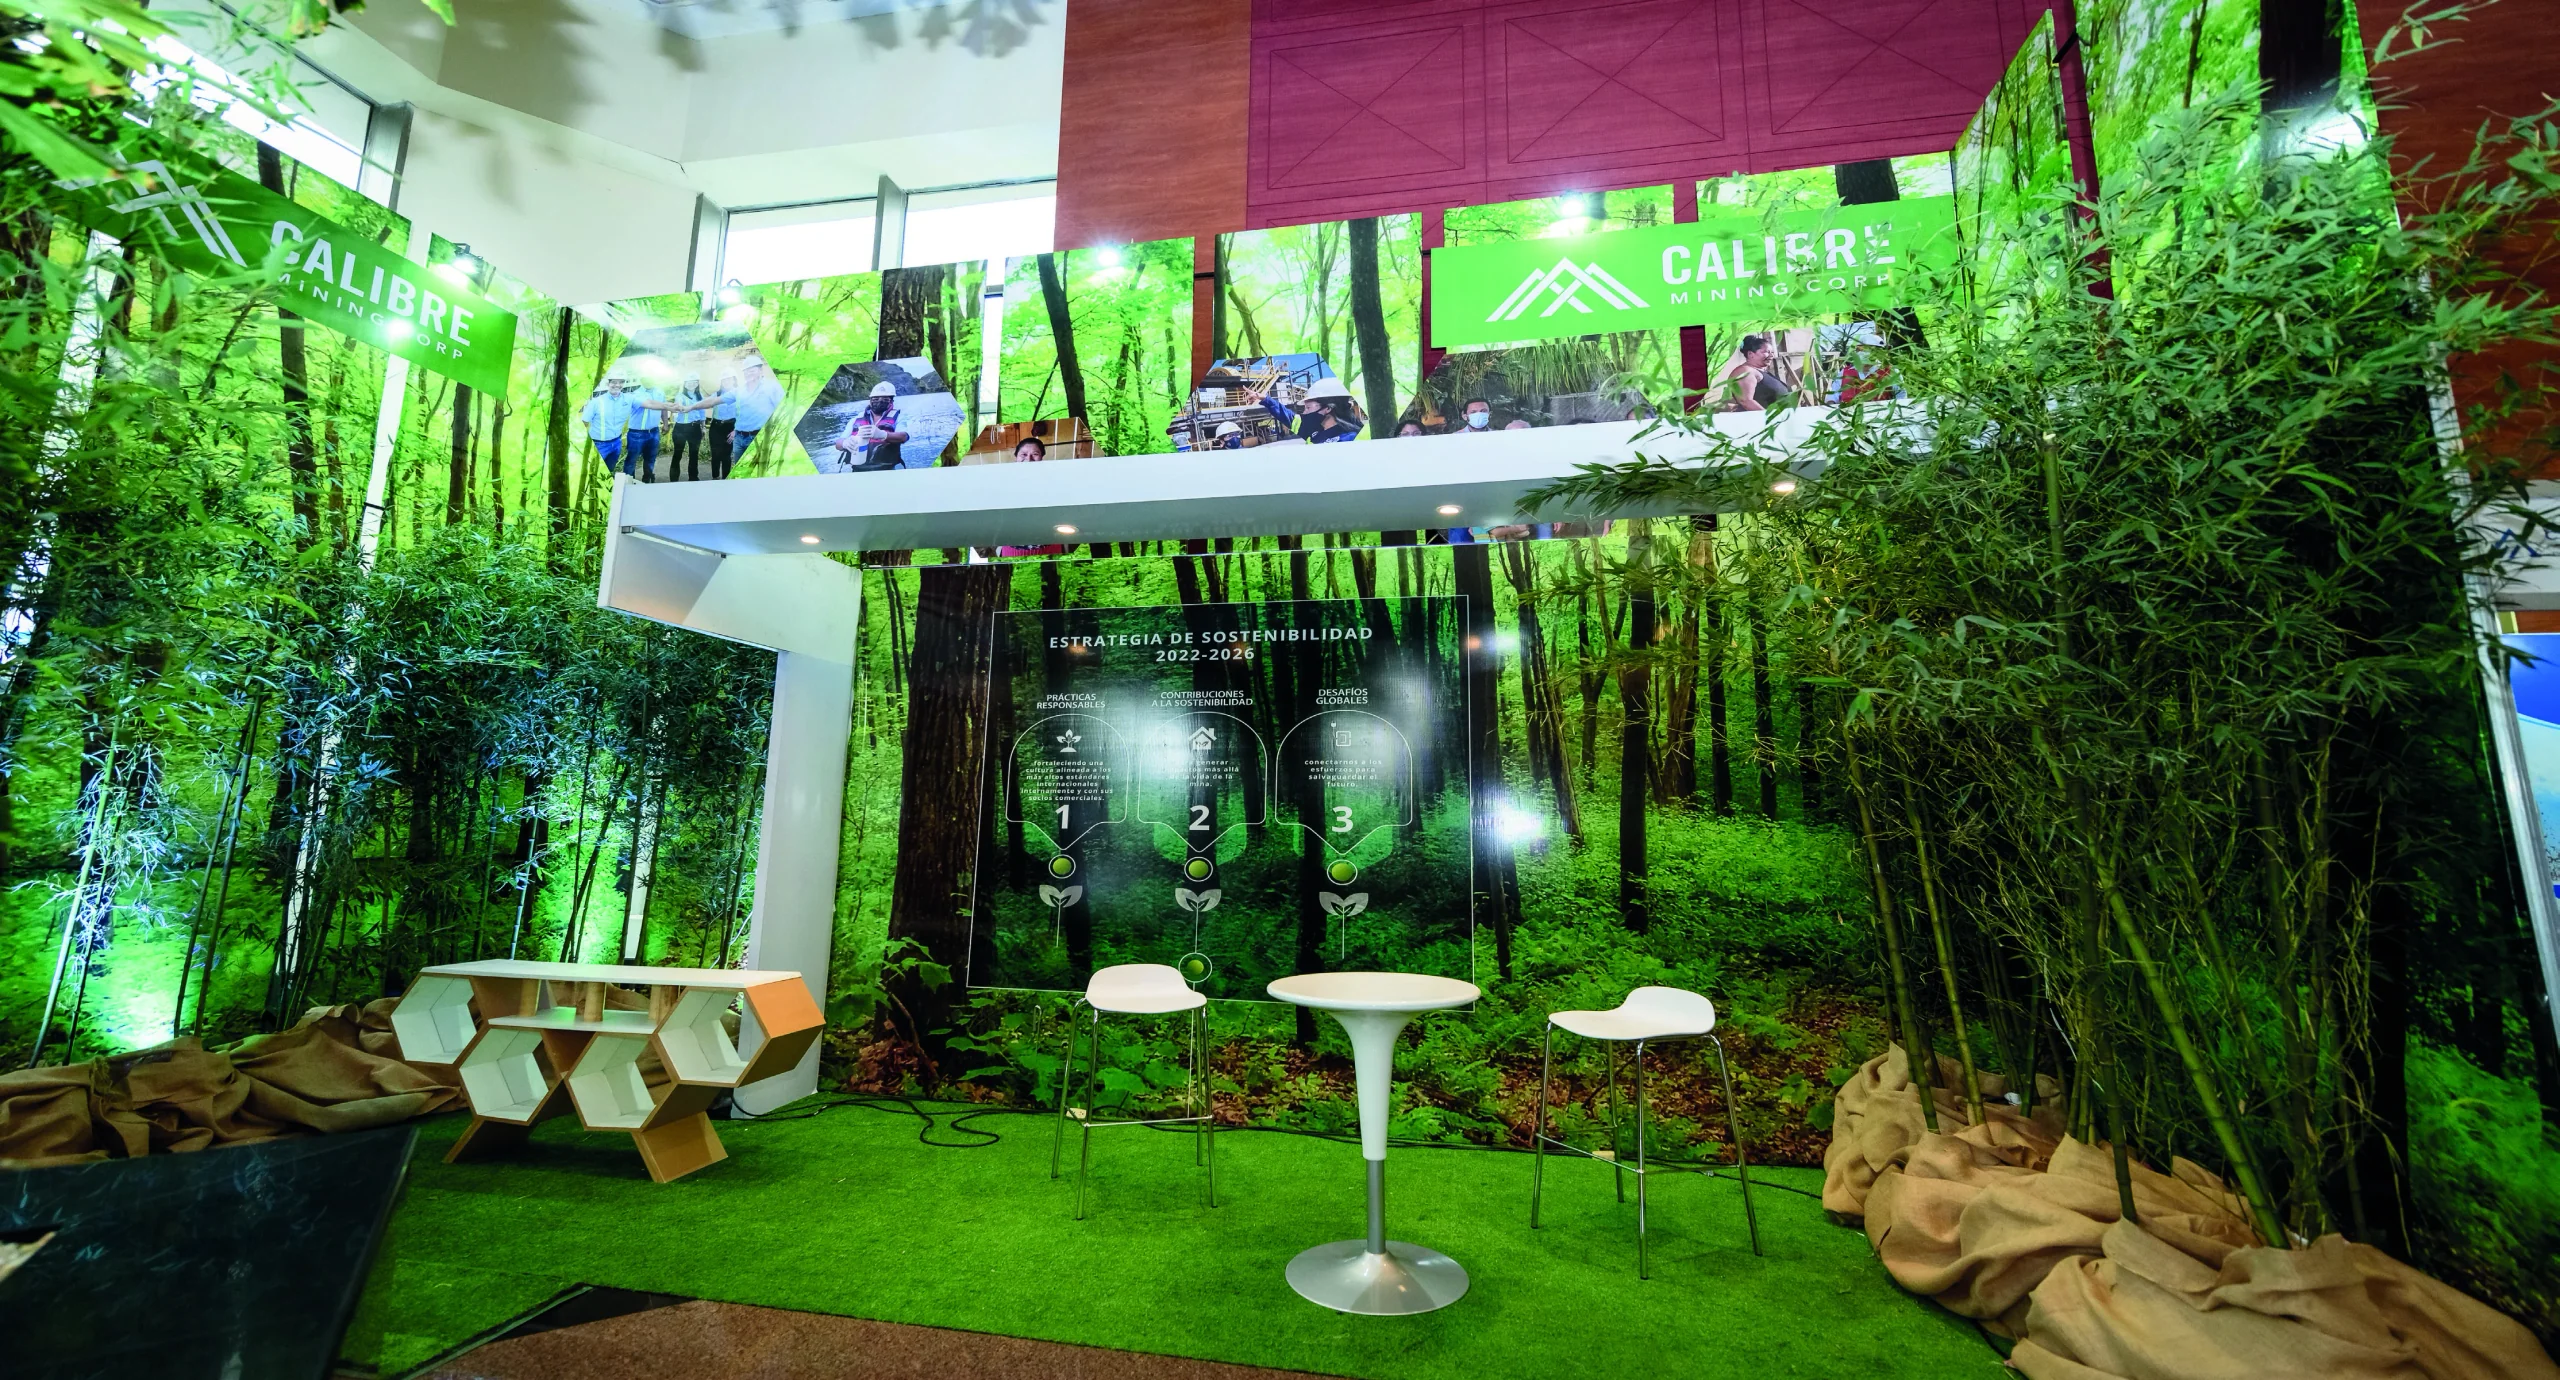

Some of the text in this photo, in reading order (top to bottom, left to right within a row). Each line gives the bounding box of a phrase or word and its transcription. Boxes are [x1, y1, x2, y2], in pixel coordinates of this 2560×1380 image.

[1661, 224, 1896, 285] CALIBRE
[269, 220, 475, 347] CALIBRE
[1670, 274, 1890, 305] MINING CORP
[1050, 627, 1373, 648] ESTRATEGIA DE SOSTENIBILIDAD
[1156, 647, 1255, 662] 2022-2026
[1046, 692, 1097, 701] PRÁCTICAS
[1160, 690, 1244, 699] CONTRIBUCIONES
[1318, 687, 1368, 697] DESAFÍOS
[1036, 700, 1106, 709] RESPONSABLES
[1151, 698, 1253, 707] A LA SOSTENIBILIDAD
[1315, 696, 1368, 705] GLOBALES
[1308, 773, 1366, 781] salvaguardar
[1055, 804, 1070, 830] 1
[1188, 804, 1210, 831] 2
[1331, 805, 1354, 833] 3
